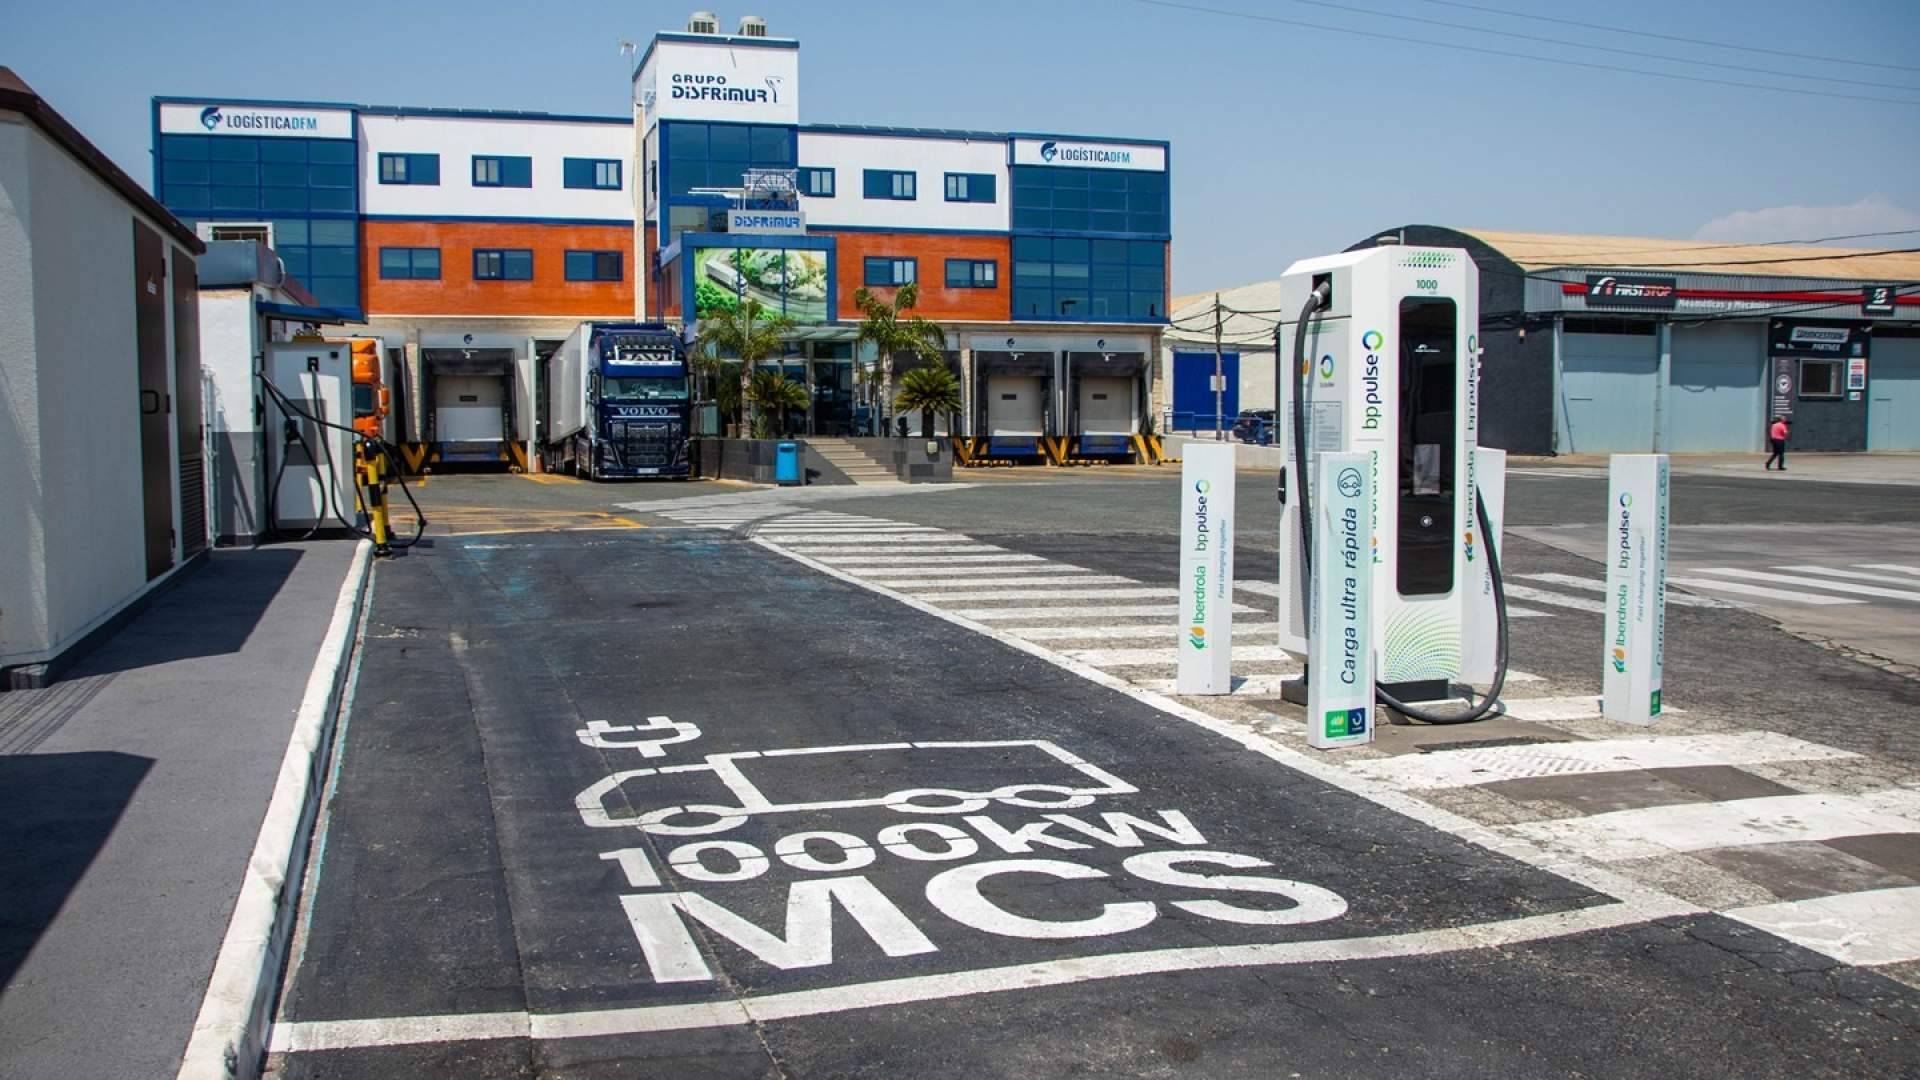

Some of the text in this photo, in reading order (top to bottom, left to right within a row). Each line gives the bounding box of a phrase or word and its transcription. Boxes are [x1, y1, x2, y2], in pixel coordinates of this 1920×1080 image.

[672, 74, 726, 84] GRUPO
[1416, 280, 1438, 289] 1000
[618, 407, 668, 416] VOLVO
[1193, 566, 1206, 624] Iberdrola
[1340, 507, 1360, 685] Carga ultra rápida
[1615, 584, 1629, 646] Iberdrola
[619, 850, 1348, 983] MCS
